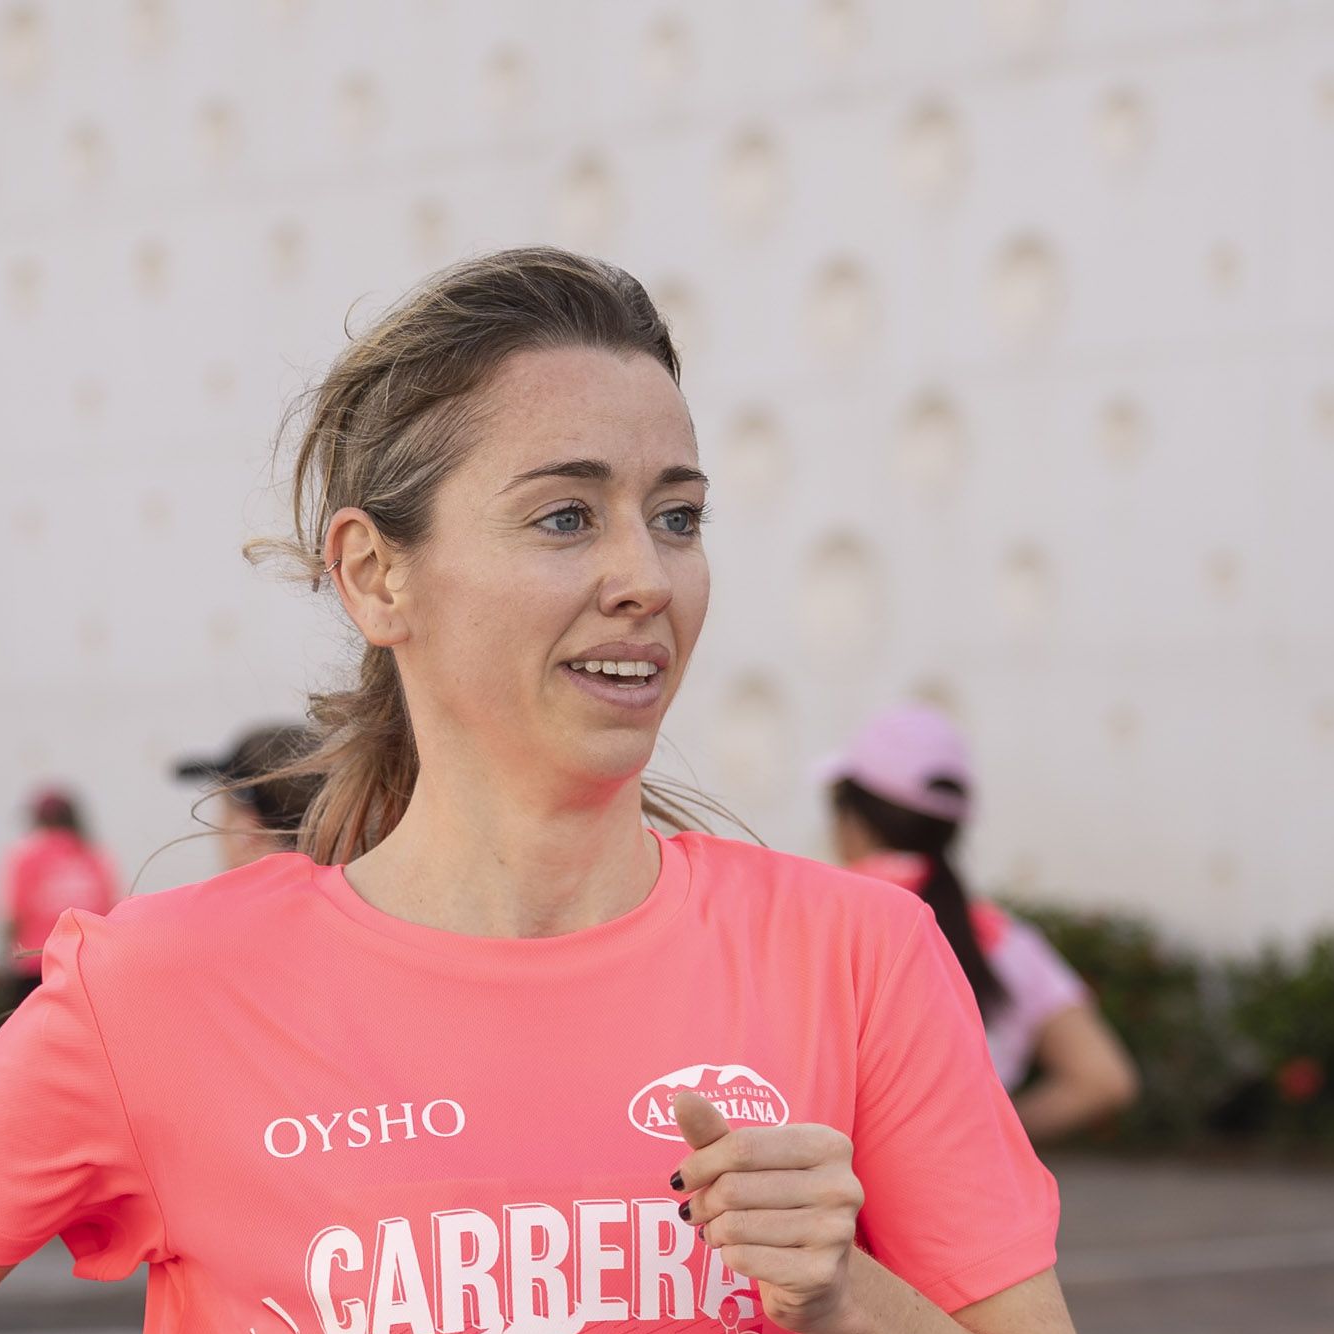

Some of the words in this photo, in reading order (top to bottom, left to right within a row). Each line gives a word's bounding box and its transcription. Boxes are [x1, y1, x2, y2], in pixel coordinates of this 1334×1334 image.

[725, 1086, 771, 1099] LECHERA
[643, 1096, 780, 1128] ASRIANA
[263, 1098, 466, 1159] OYSHO
